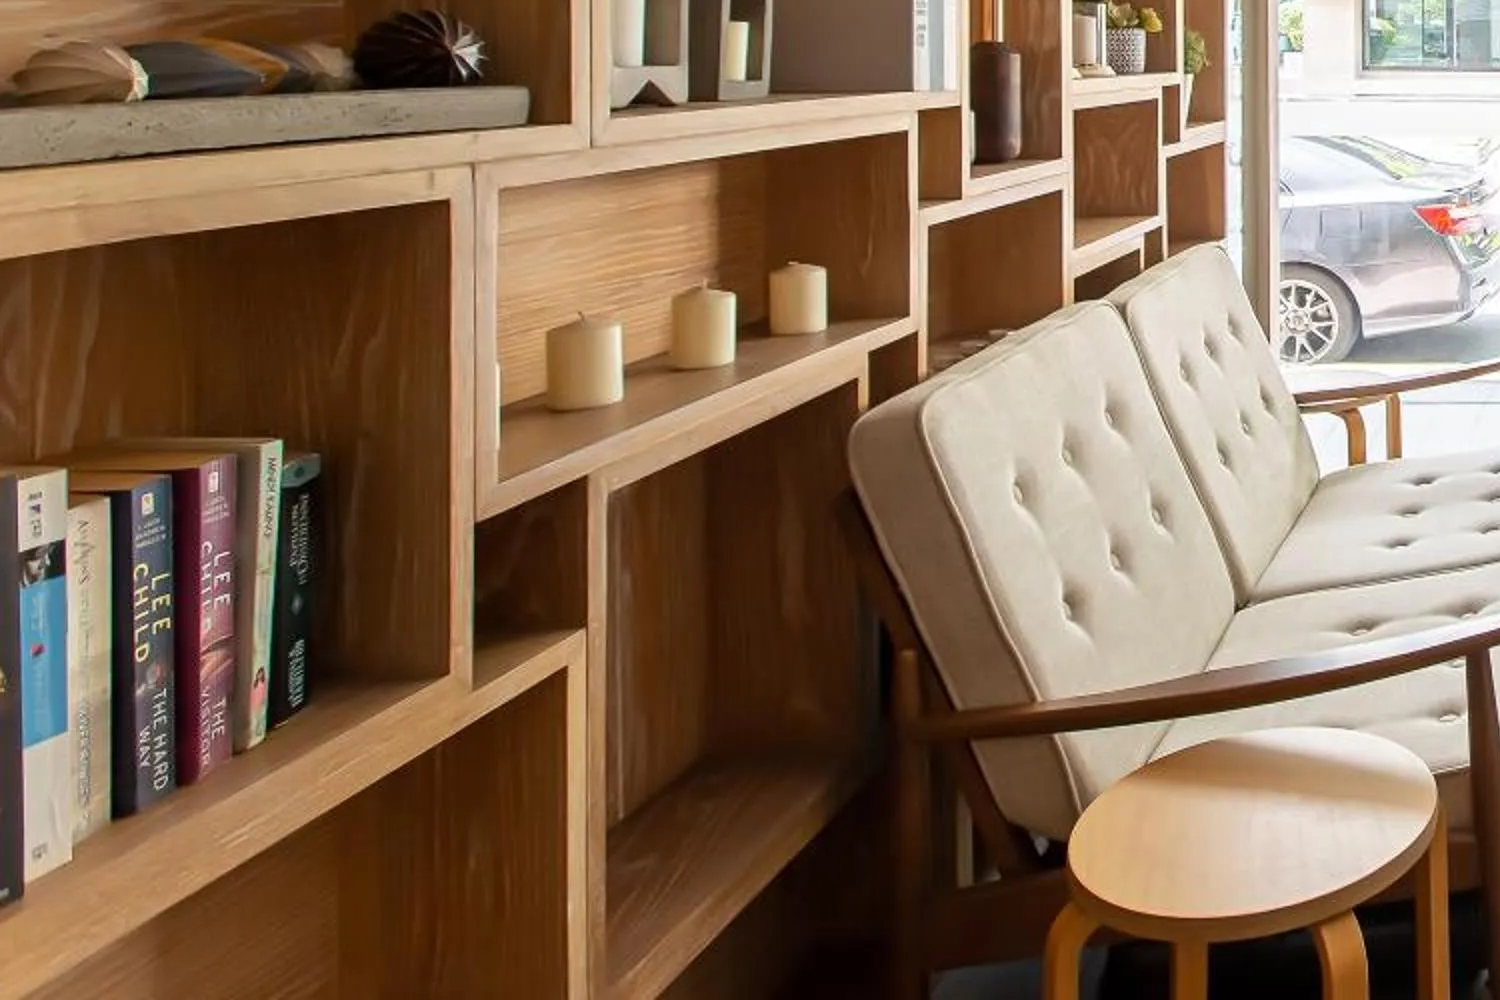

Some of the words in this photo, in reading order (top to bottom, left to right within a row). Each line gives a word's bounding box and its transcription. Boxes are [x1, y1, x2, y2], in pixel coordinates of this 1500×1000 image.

[152, 573, 171, 634] LEE
[214, 551, 231, 610] LEE
[134, 563, 149, 663] CHILD
[153, 688, 167, 730] THE
[212, 696, 227, 740] THE
[139, 725, 151, 768] WAY
[153, 732, 169, 791] HARD
